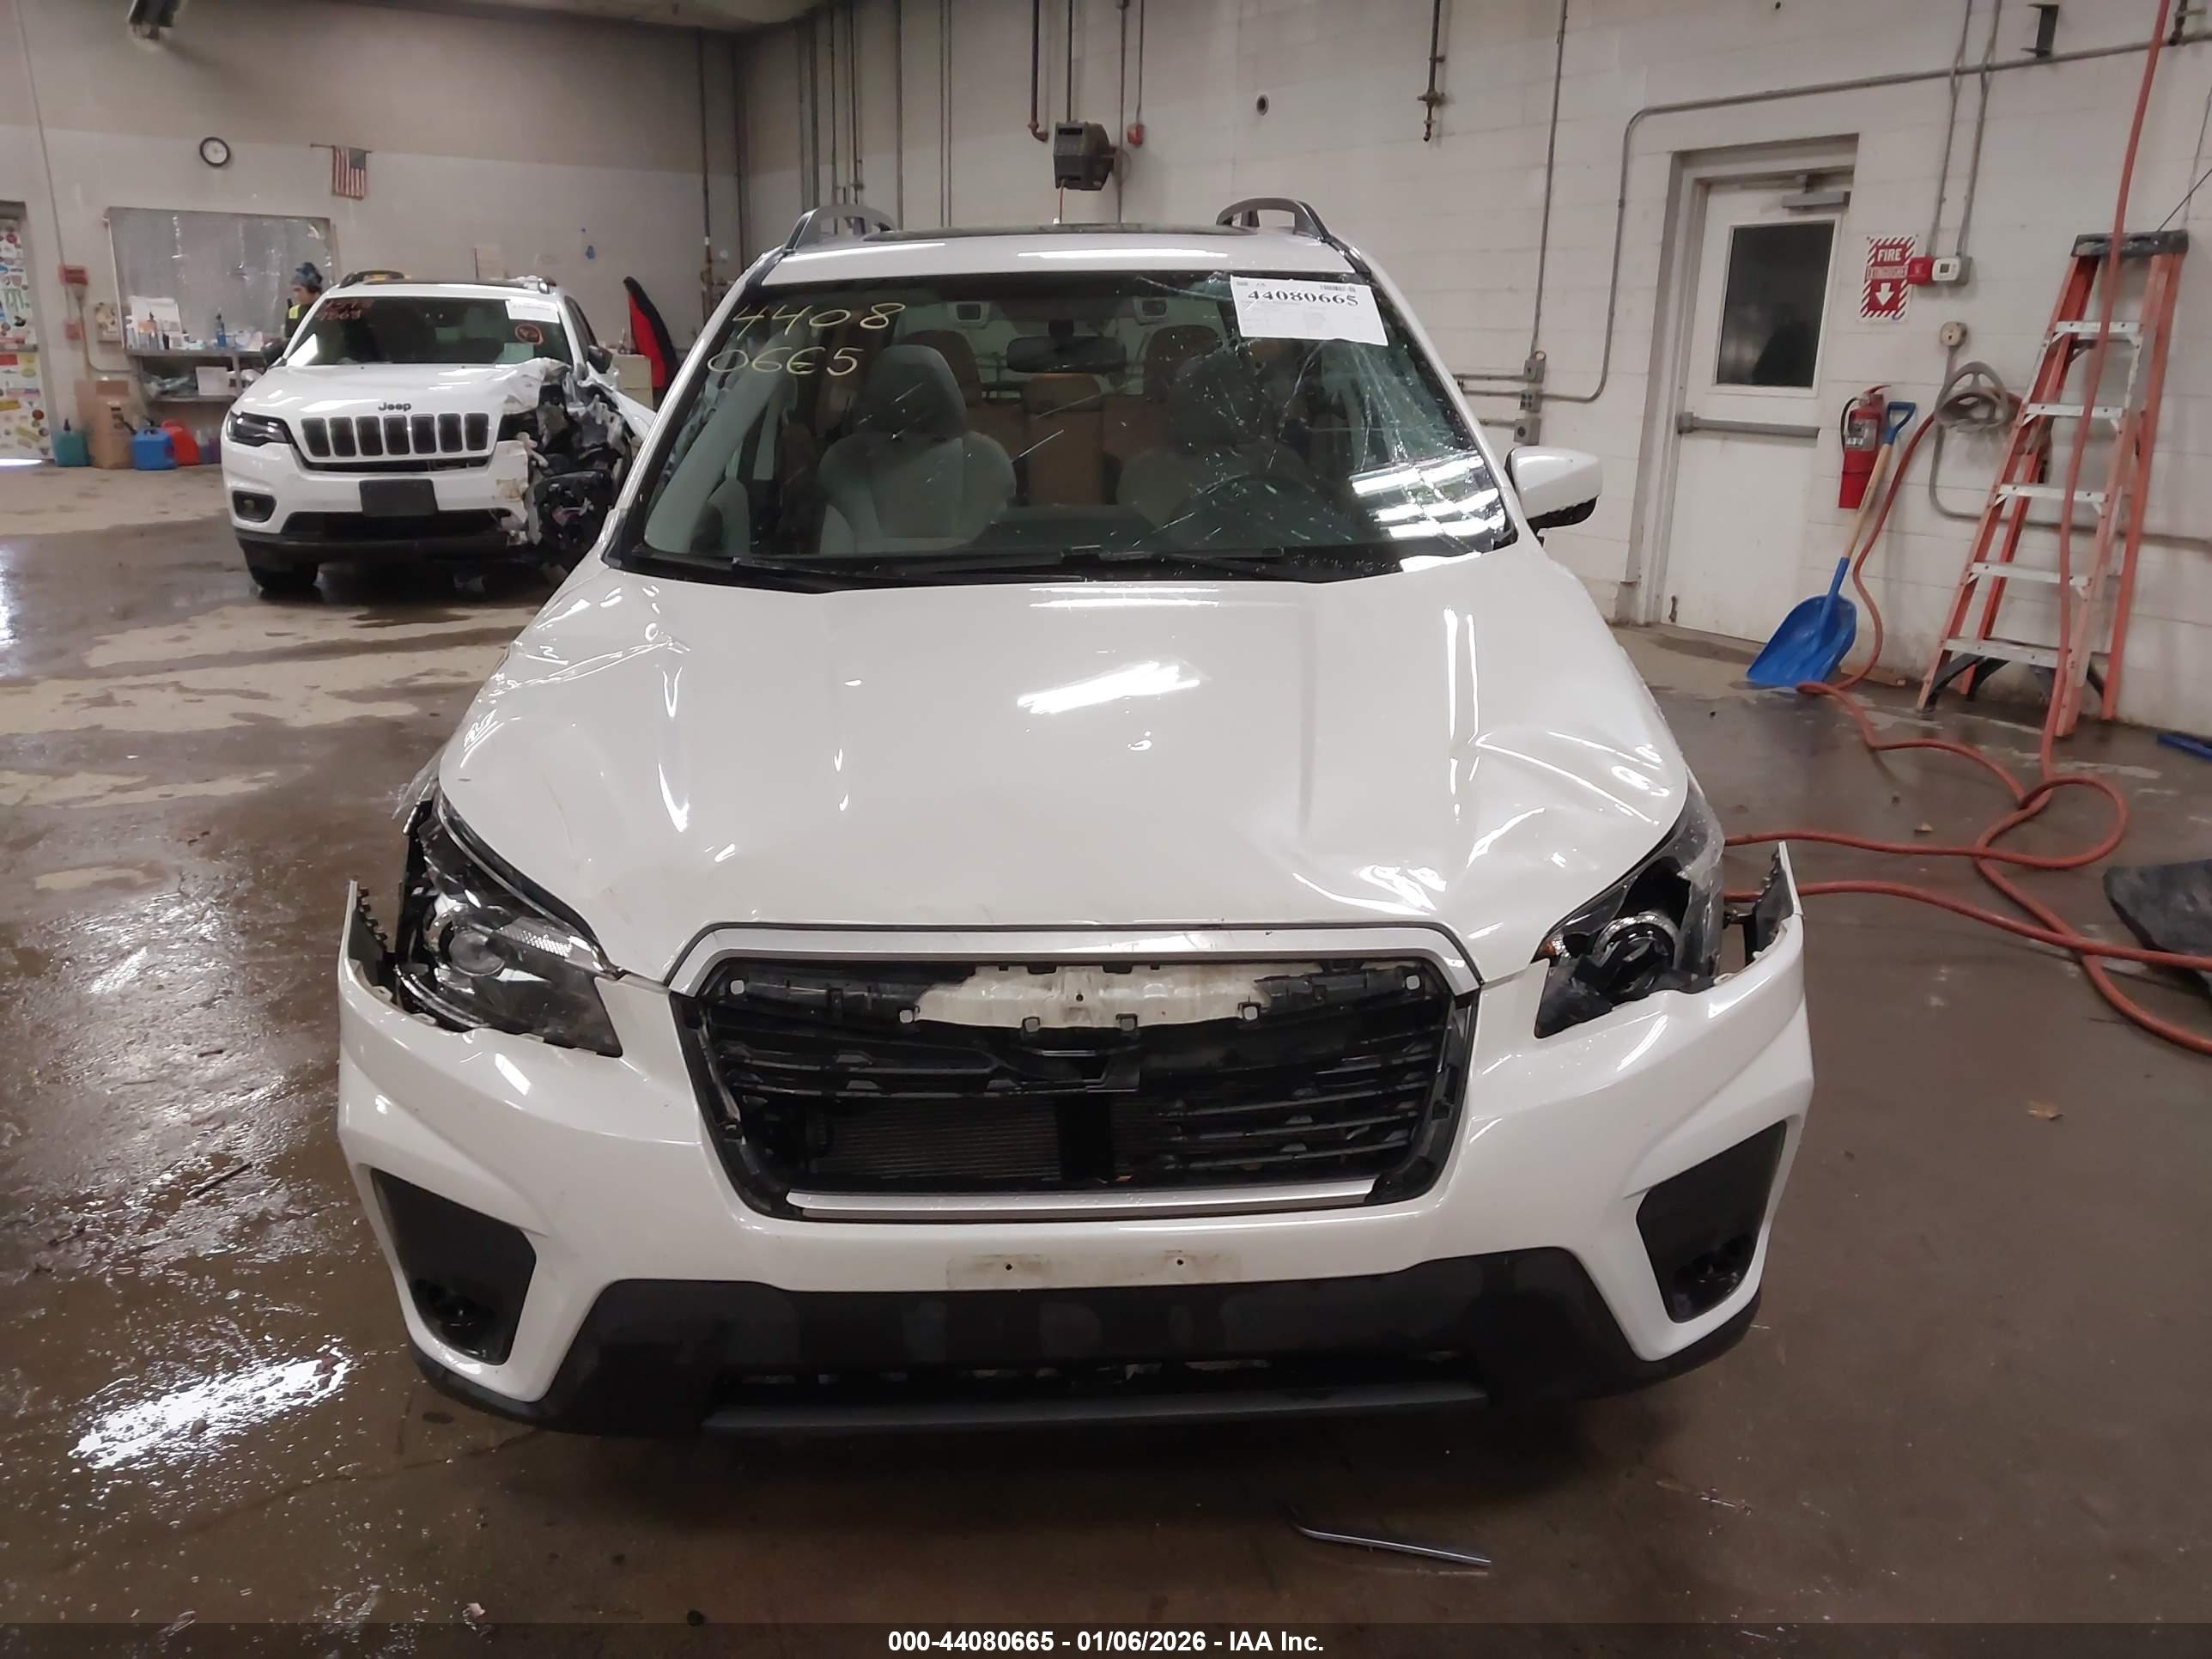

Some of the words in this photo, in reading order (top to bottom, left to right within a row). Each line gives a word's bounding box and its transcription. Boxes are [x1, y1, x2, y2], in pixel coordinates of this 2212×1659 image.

[1877, 248, 1903, 262] FIRE
[1248, 290, 1358, 307] 44080665
[732, 302, 906, 339] 4408
[378, 402, 411, 412] Jeep
